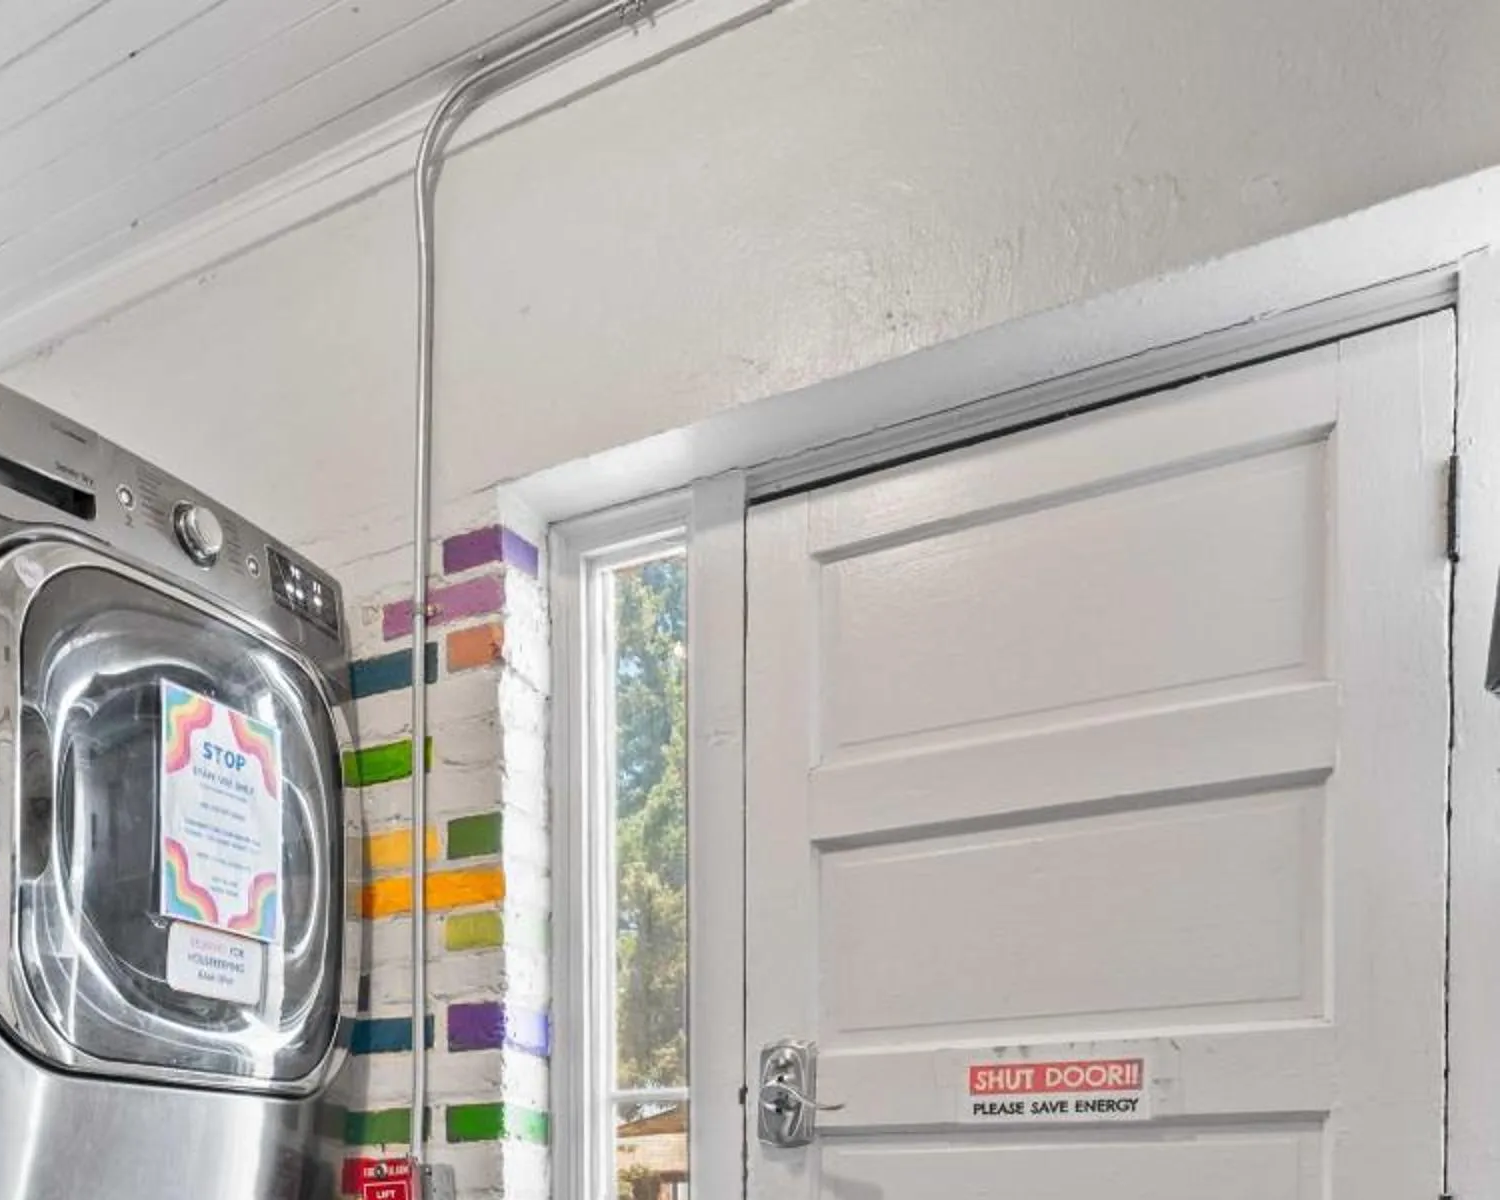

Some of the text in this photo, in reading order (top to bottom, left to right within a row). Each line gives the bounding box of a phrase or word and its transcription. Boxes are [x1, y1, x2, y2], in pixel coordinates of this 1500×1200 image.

[201, 741, 246, 773] STOP
[973, 1067, 1035, 1092] SHUT
[973, 1097, 1140, 1116] PLEASE SAVE ENERGY
[375, 1189, 396, 1200] LIFT
